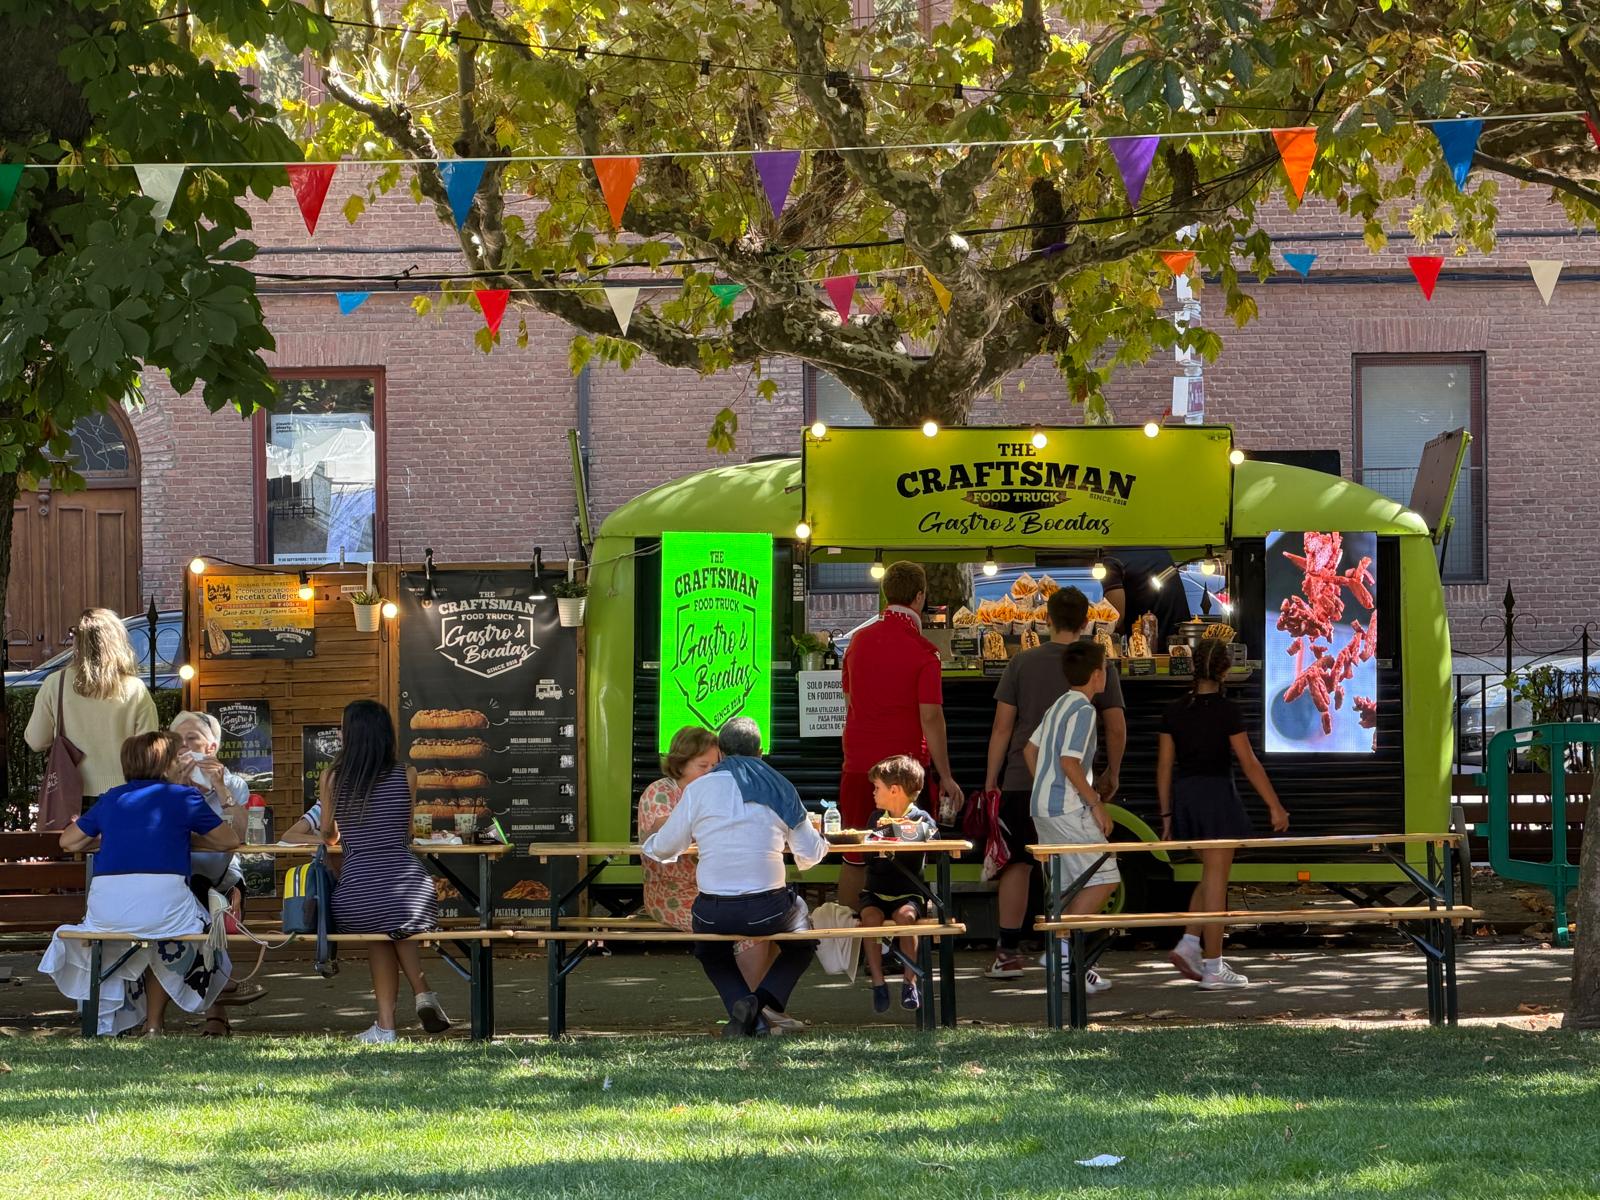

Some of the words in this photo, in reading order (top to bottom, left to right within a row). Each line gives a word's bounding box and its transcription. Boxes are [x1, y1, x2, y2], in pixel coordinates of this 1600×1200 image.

[998, 443, 1037, 457] THE
[897, 460, 1137, 500] CRAFTSMAN
[973, 492, 1010, 503] FOOD
[1012, 492, 1060, 503] TRUCK
[1089, 493, 1114, 503] SINCE
[918, 511, 1001, 535] Gastro
[1004, 517, 1016, 532] &
[1019, 512, 1114, 535] Bocatas
[710, 550, 724, 564] THE
[674, 566, 759, 600] CRAFTSMAN
[235, 592, 265, 600] recetas
[438, 599, 536, 615] CRAFTSMAN
[694, 597, 713, 612] FOOD
[715, 598, 739, 613] TRUCK
[461, 613, 484, 621] FOOD
[486, 613, 514, 621] TRUCK
[269, 627, 312, 637] CRAFTSMAN
[445, 624, 512, 647] Gastro
[514, 624, 525, 638] &
[679, 620, 736, 666] Gastro
[463, 642, 530, 665] Bocatas
[695, 656, 752, 703] Bocatas
[807, 681, 822, 689] SOLO
[808, 692, 815, 700] EN
[817, 691, 844, 700] FOODTRU
[217, 750, 268, 759] RAFTSMAN
[495, 909, 519, 917] PATATAS
[520, 908, 551, 917] CRUJIENTE
